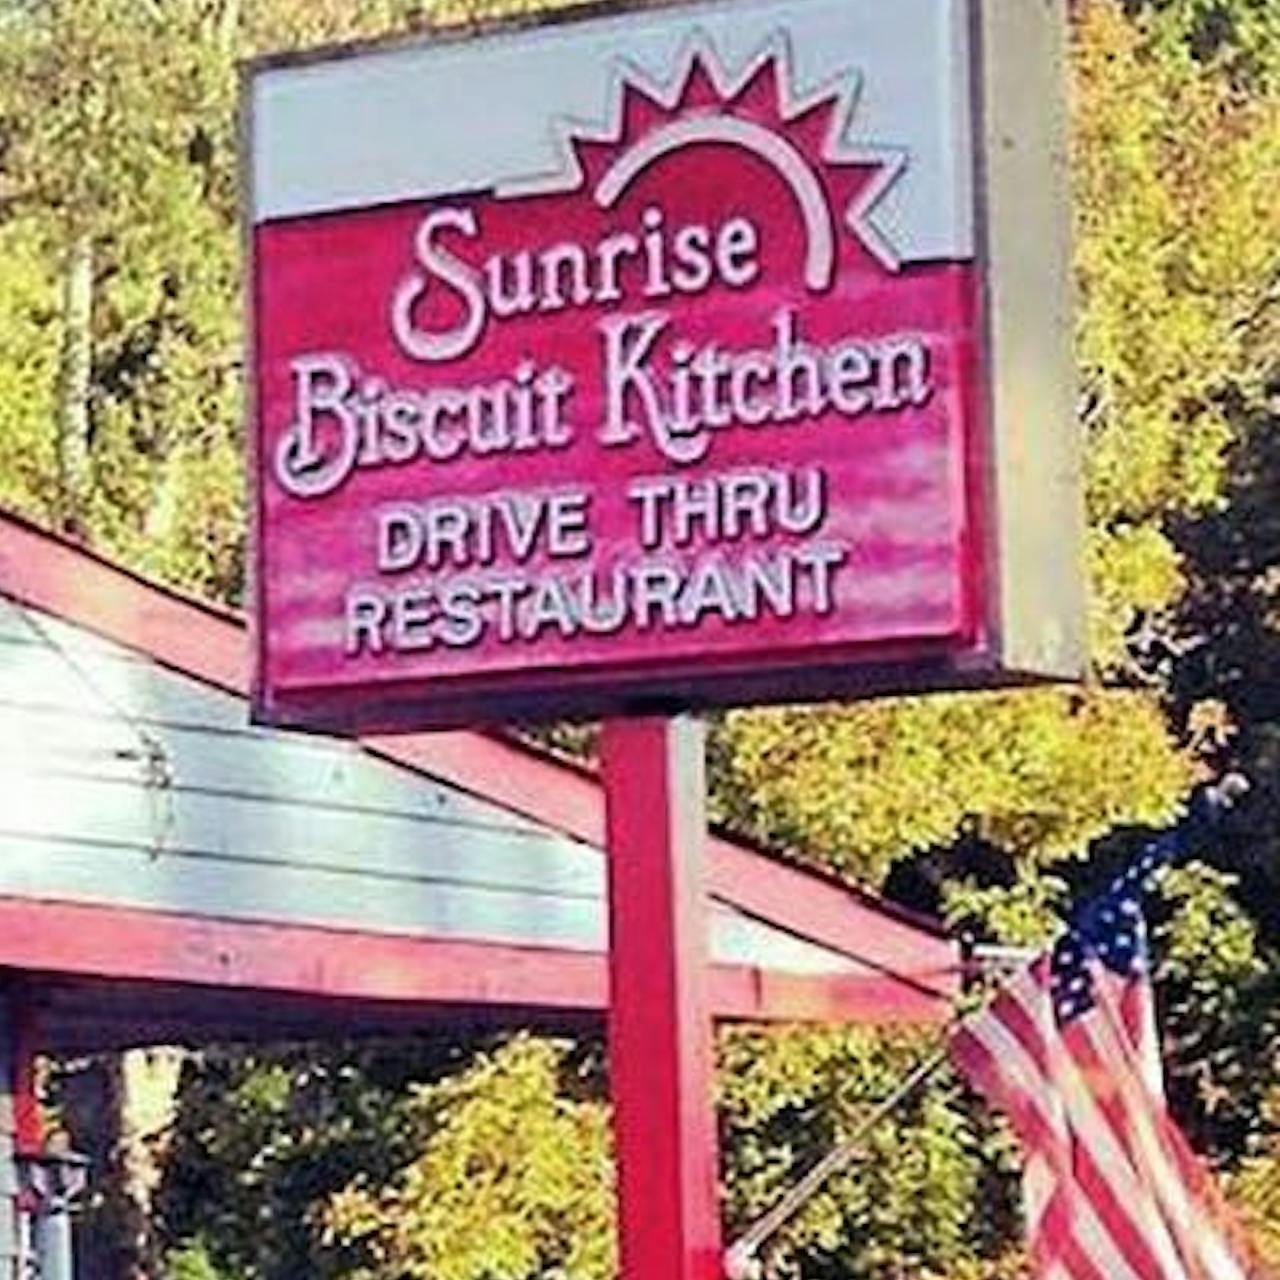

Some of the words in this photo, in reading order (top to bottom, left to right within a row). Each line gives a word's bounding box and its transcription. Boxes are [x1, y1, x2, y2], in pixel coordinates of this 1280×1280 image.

[393, 207, 758, 361] Sunrise
[276, 355, 573, 496] Biscuit
[600, 312, 932, 462] Kitchen
[377, 492, 590, 571] DRIVE
[631, 469, 826, 548] THRU
[344, 549, 844, 654] RESTAURANT
